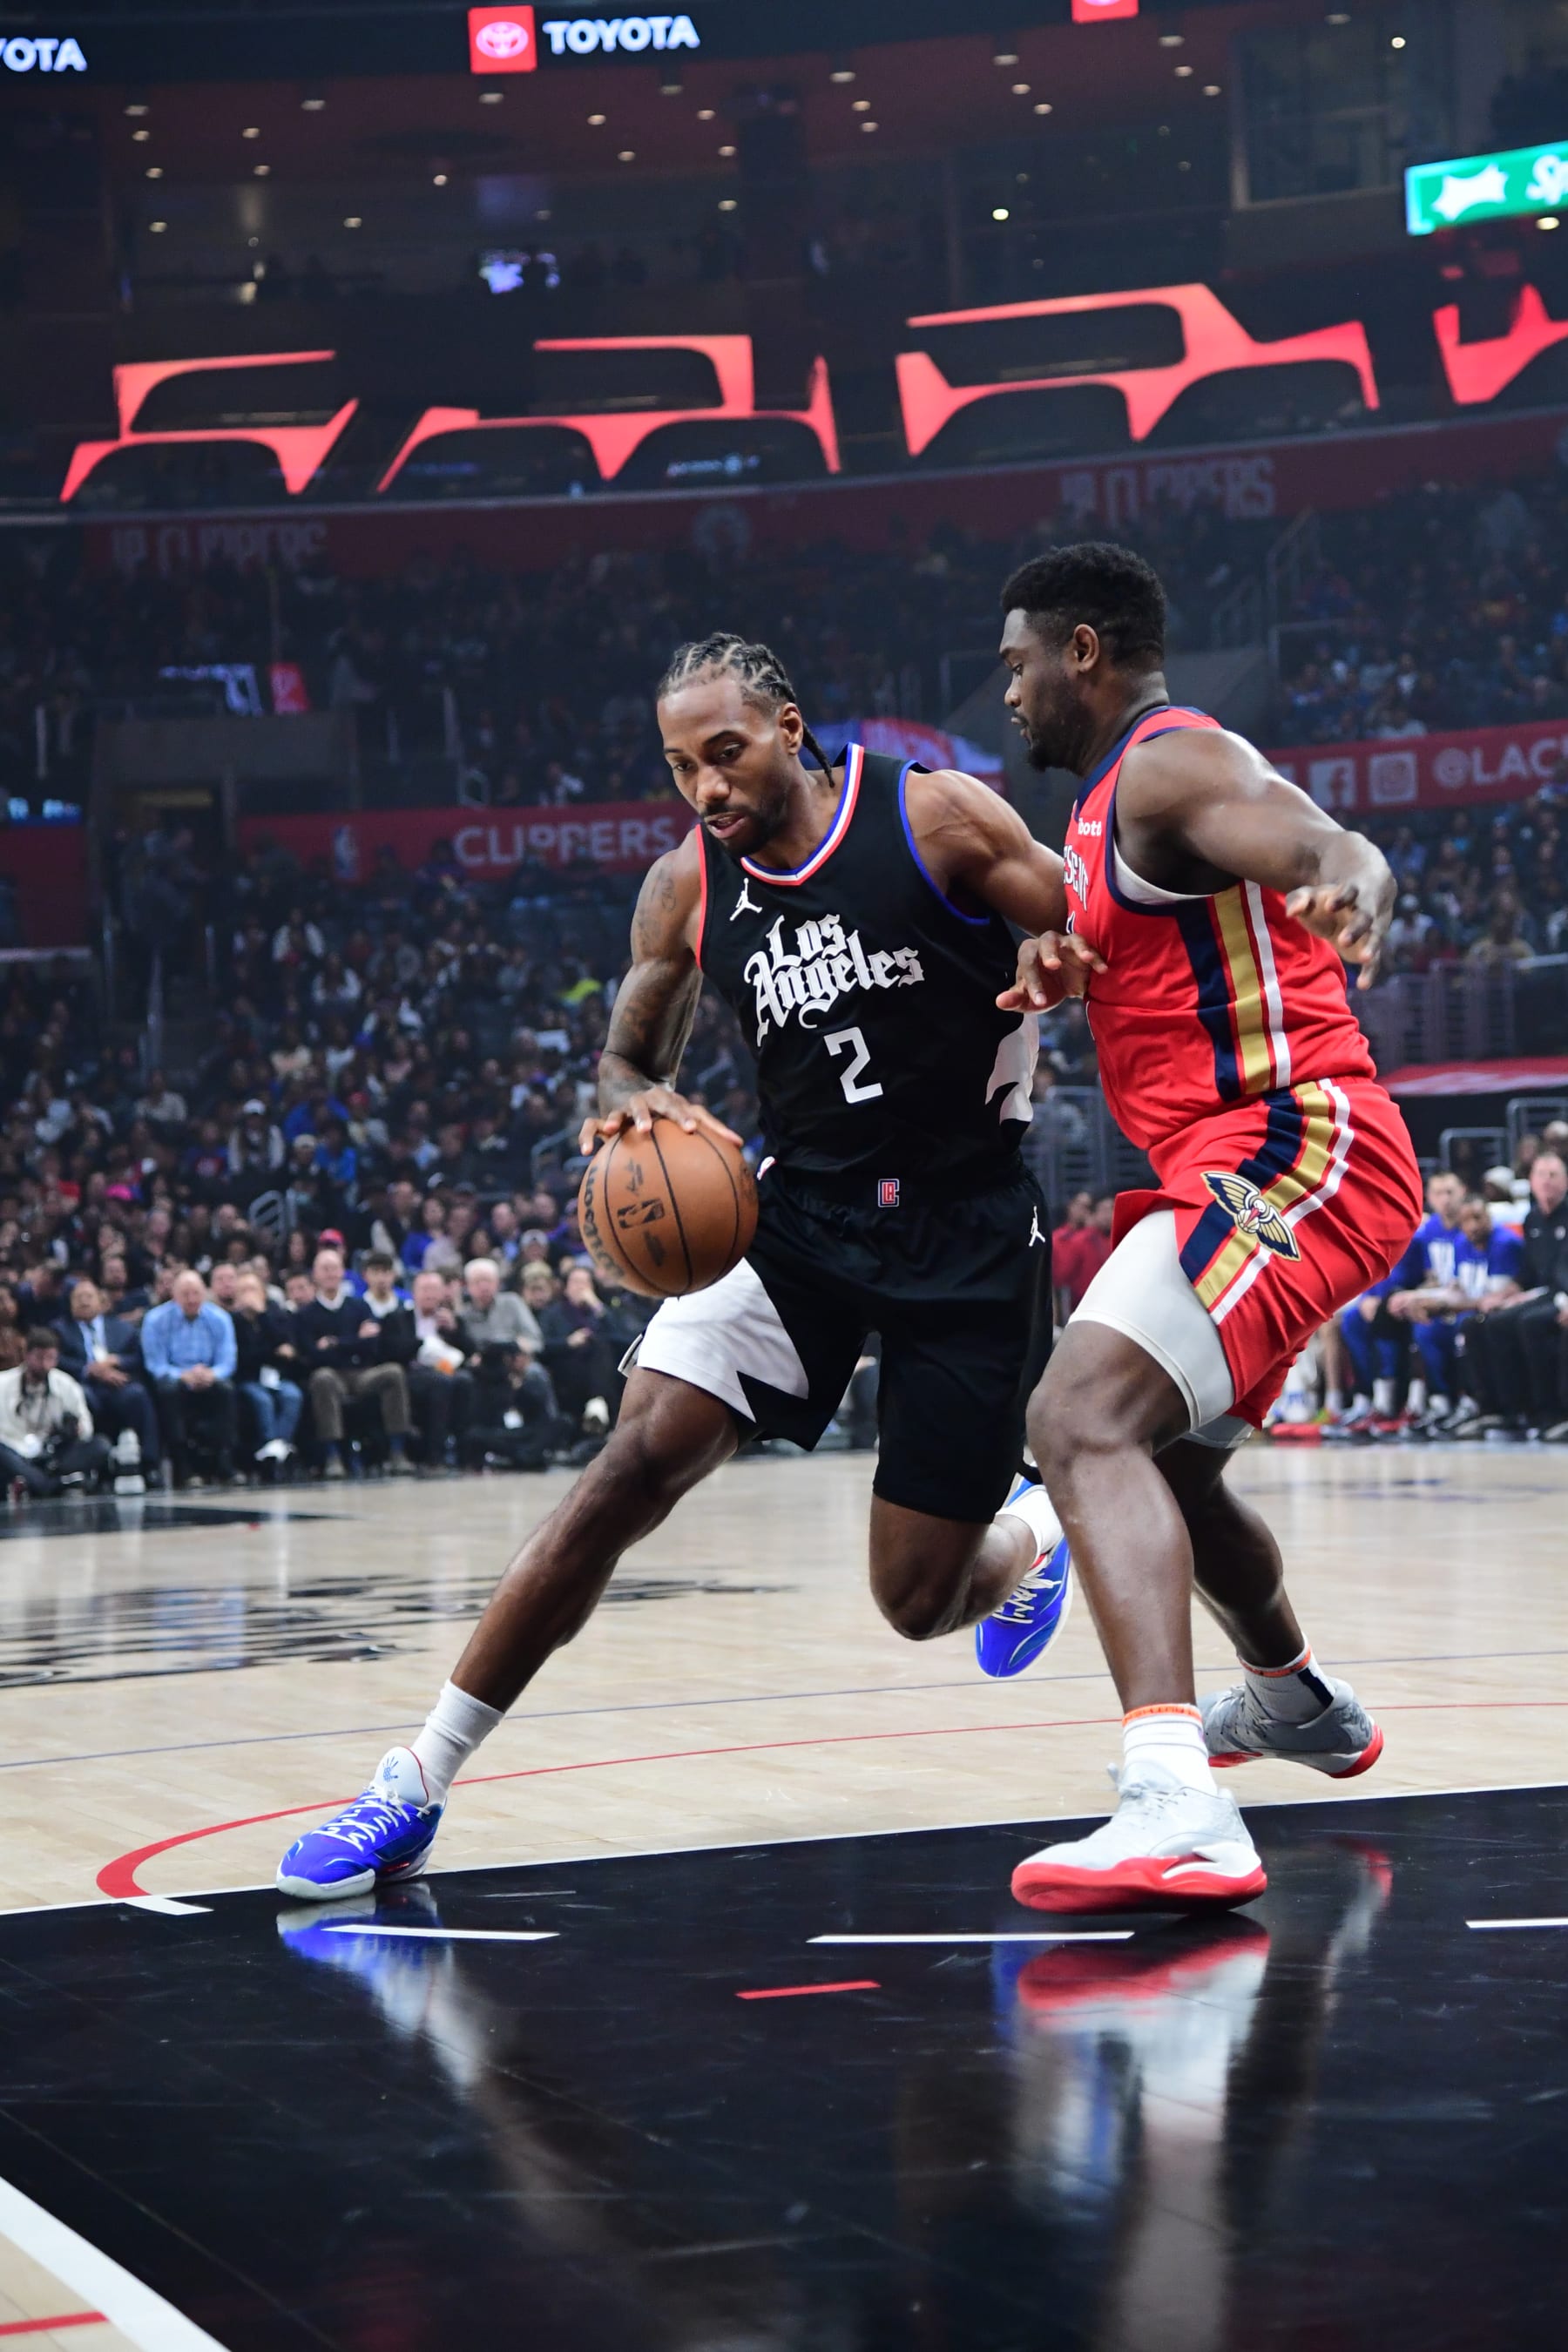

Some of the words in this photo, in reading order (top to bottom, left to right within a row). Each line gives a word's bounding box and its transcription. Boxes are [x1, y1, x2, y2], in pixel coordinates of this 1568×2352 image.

[0, 37, 88, 72] OTA
[542, 15, 701, 55] TOYOTA
[1432, 733, 1568, 790] @LAC
[451, 815, 677, 865] CLIPPERS
[766, 913, 848, 972] Los
[743, 929, 925, 1048] Angeles
[823, 1025, 884, 1105] 2
